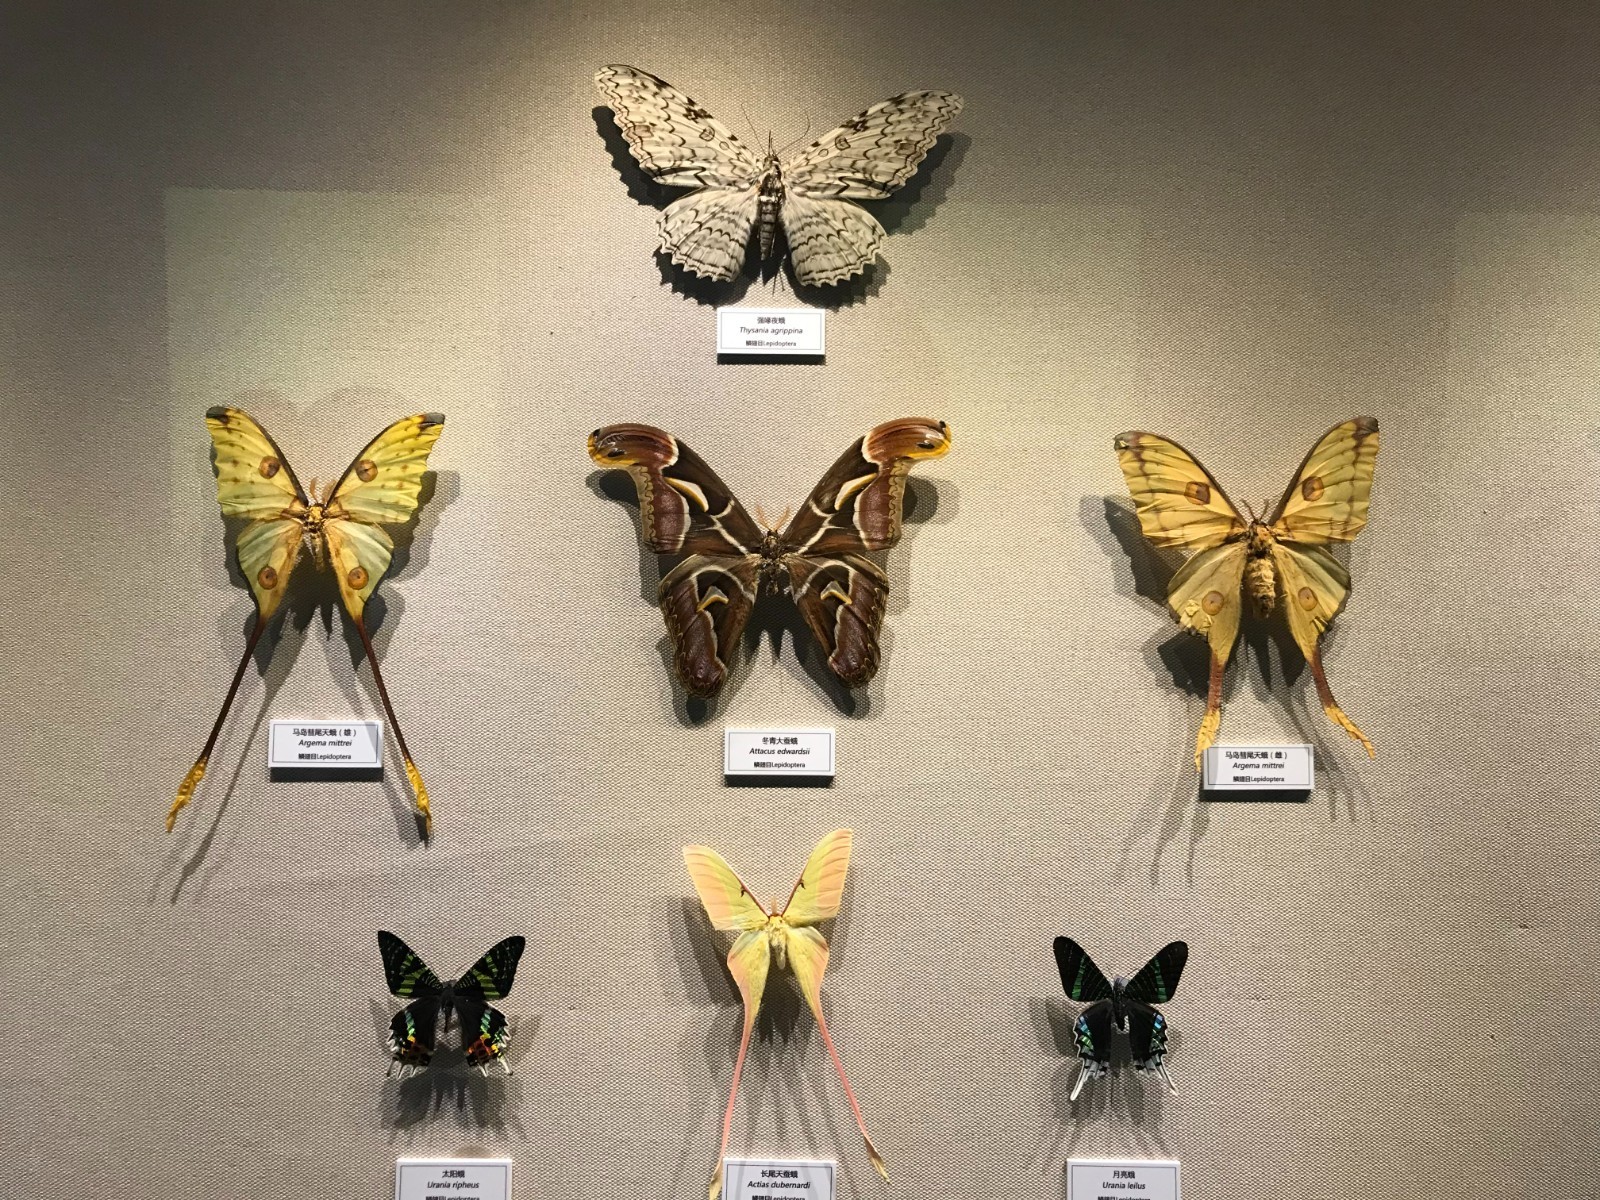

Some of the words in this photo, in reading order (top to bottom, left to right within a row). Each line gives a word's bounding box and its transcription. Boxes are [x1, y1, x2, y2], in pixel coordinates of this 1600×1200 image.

[298, 740, 326, 748] Argema
[442, 1170, 465, 1178] 太阳蛾
[761, 1170, 798, 1178] 长尾天蚕蛾
[1113, 1170, 1135, 1179] 月亮蛾
[452, 1181, 479, 1190] ripheus
